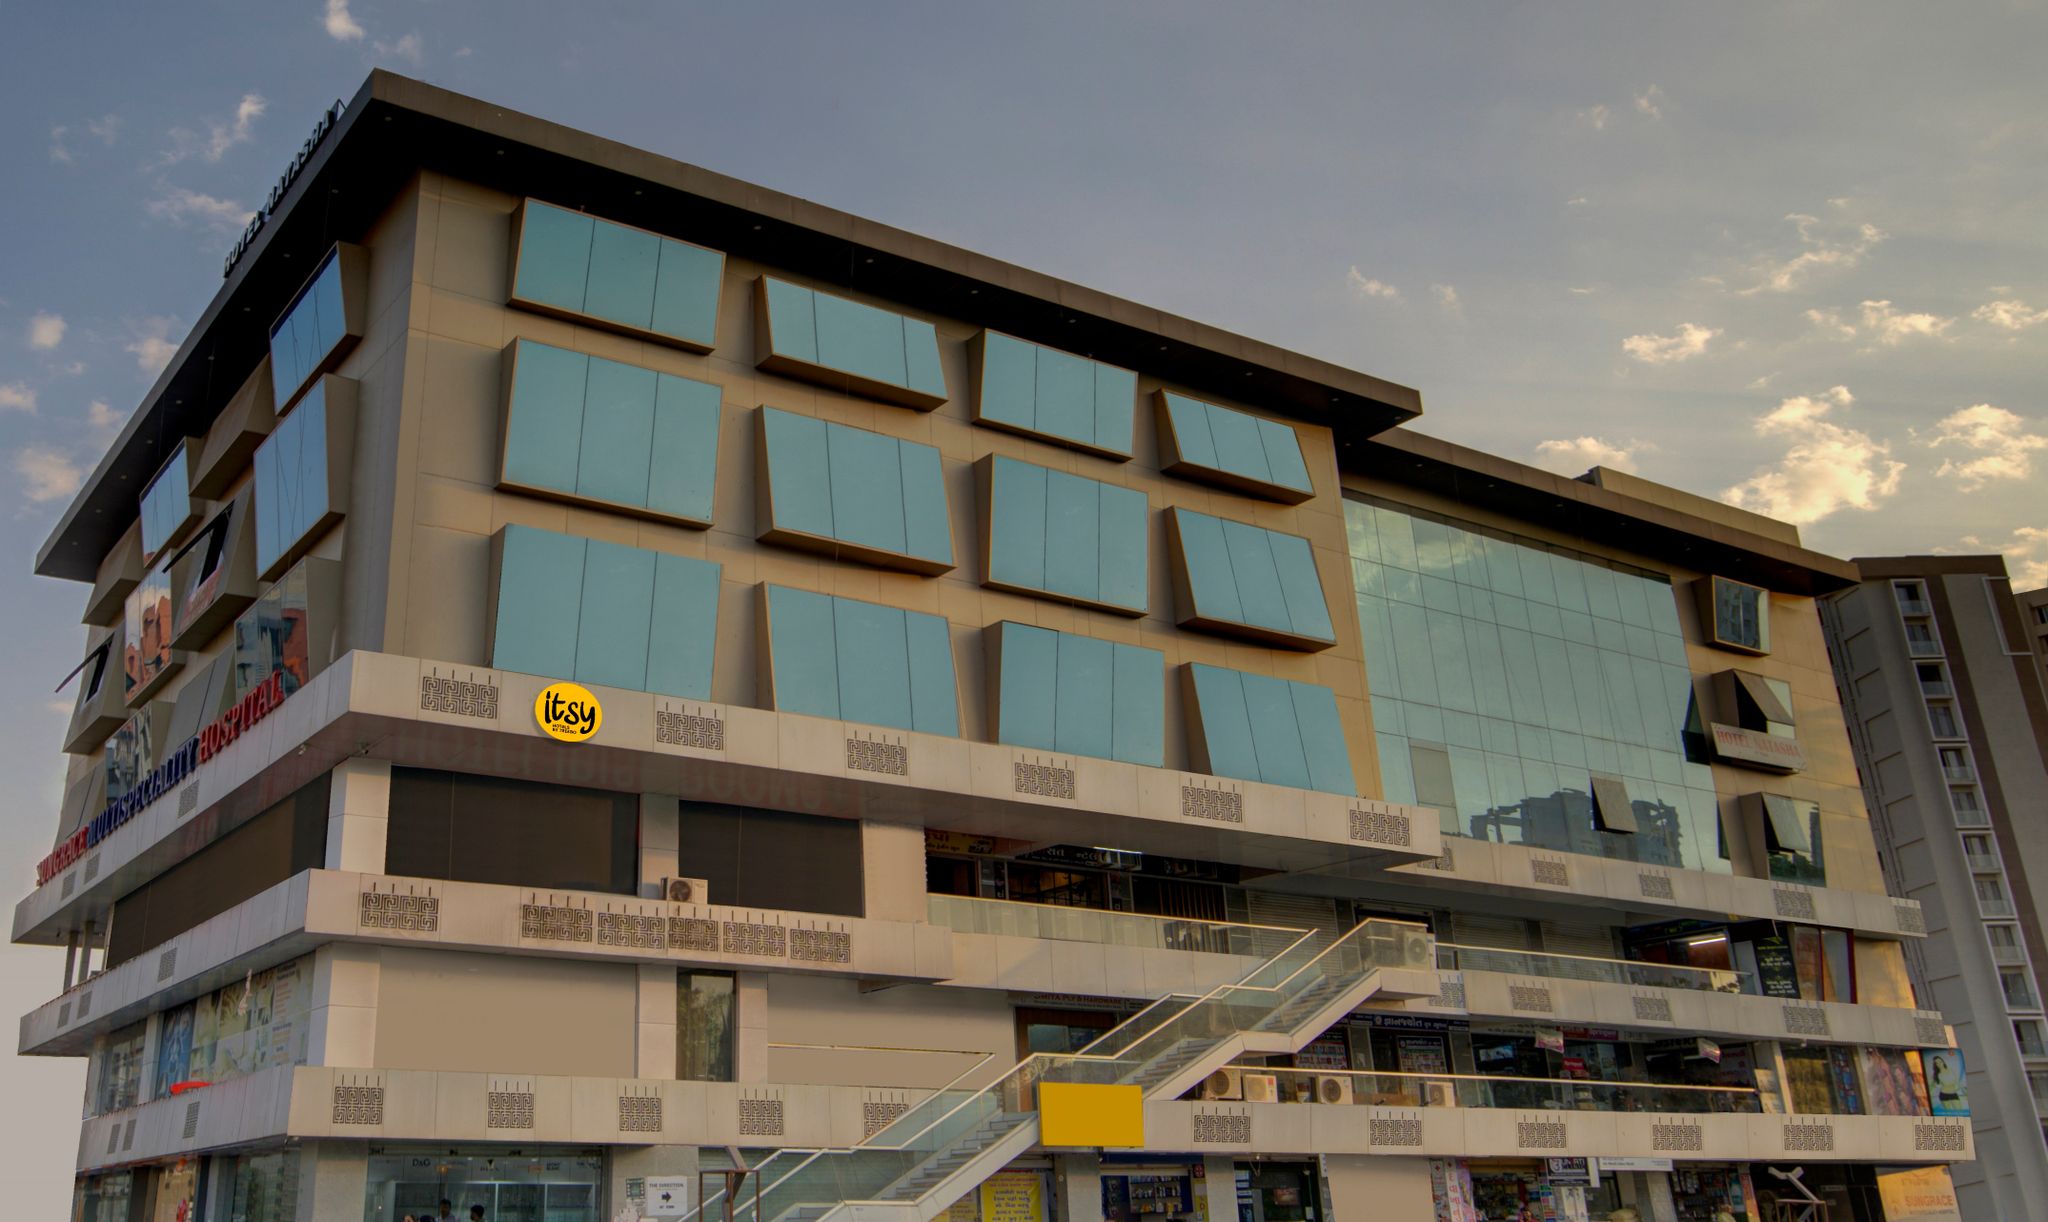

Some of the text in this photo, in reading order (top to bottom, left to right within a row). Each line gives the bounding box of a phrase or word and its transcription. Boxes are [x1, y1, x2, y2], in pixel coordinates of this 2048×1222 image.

[224, 210, 266, 278] HOTEL
[544, 690, 596, 735] itsy
[87, 736, 200, 849] MULTISPECIALITY
[198, 669, 285, 765] HOSPITAL
[1716, 730, 1751, 748] HOTEL
[1904, 1195, 1954, 1208] SUNGRACE
